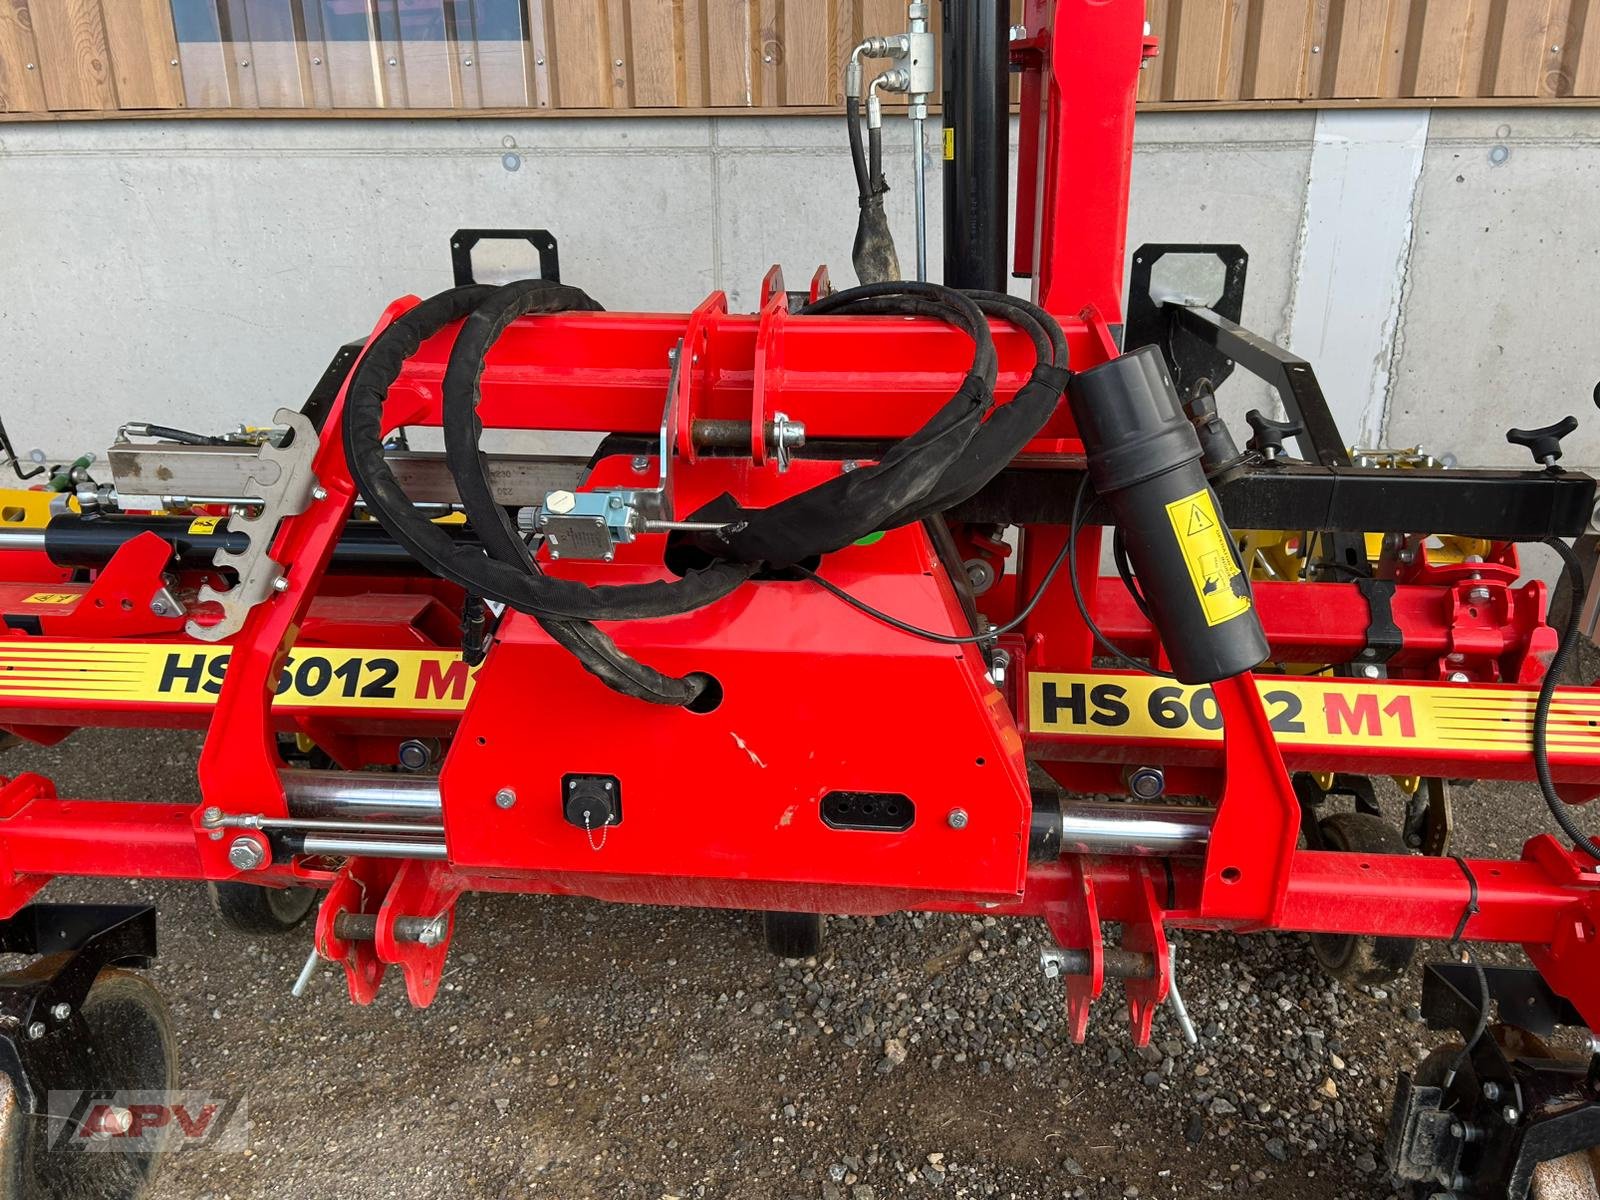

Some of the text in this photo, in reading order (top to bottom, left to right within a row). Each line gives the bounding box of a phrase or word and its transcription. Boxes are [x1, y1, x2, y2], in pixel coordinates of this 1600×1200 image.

[158, 653, 231, 694] HS
[414, 660, 481, 700] M
[1042, 682, 1417, 738] HS 602 M1
